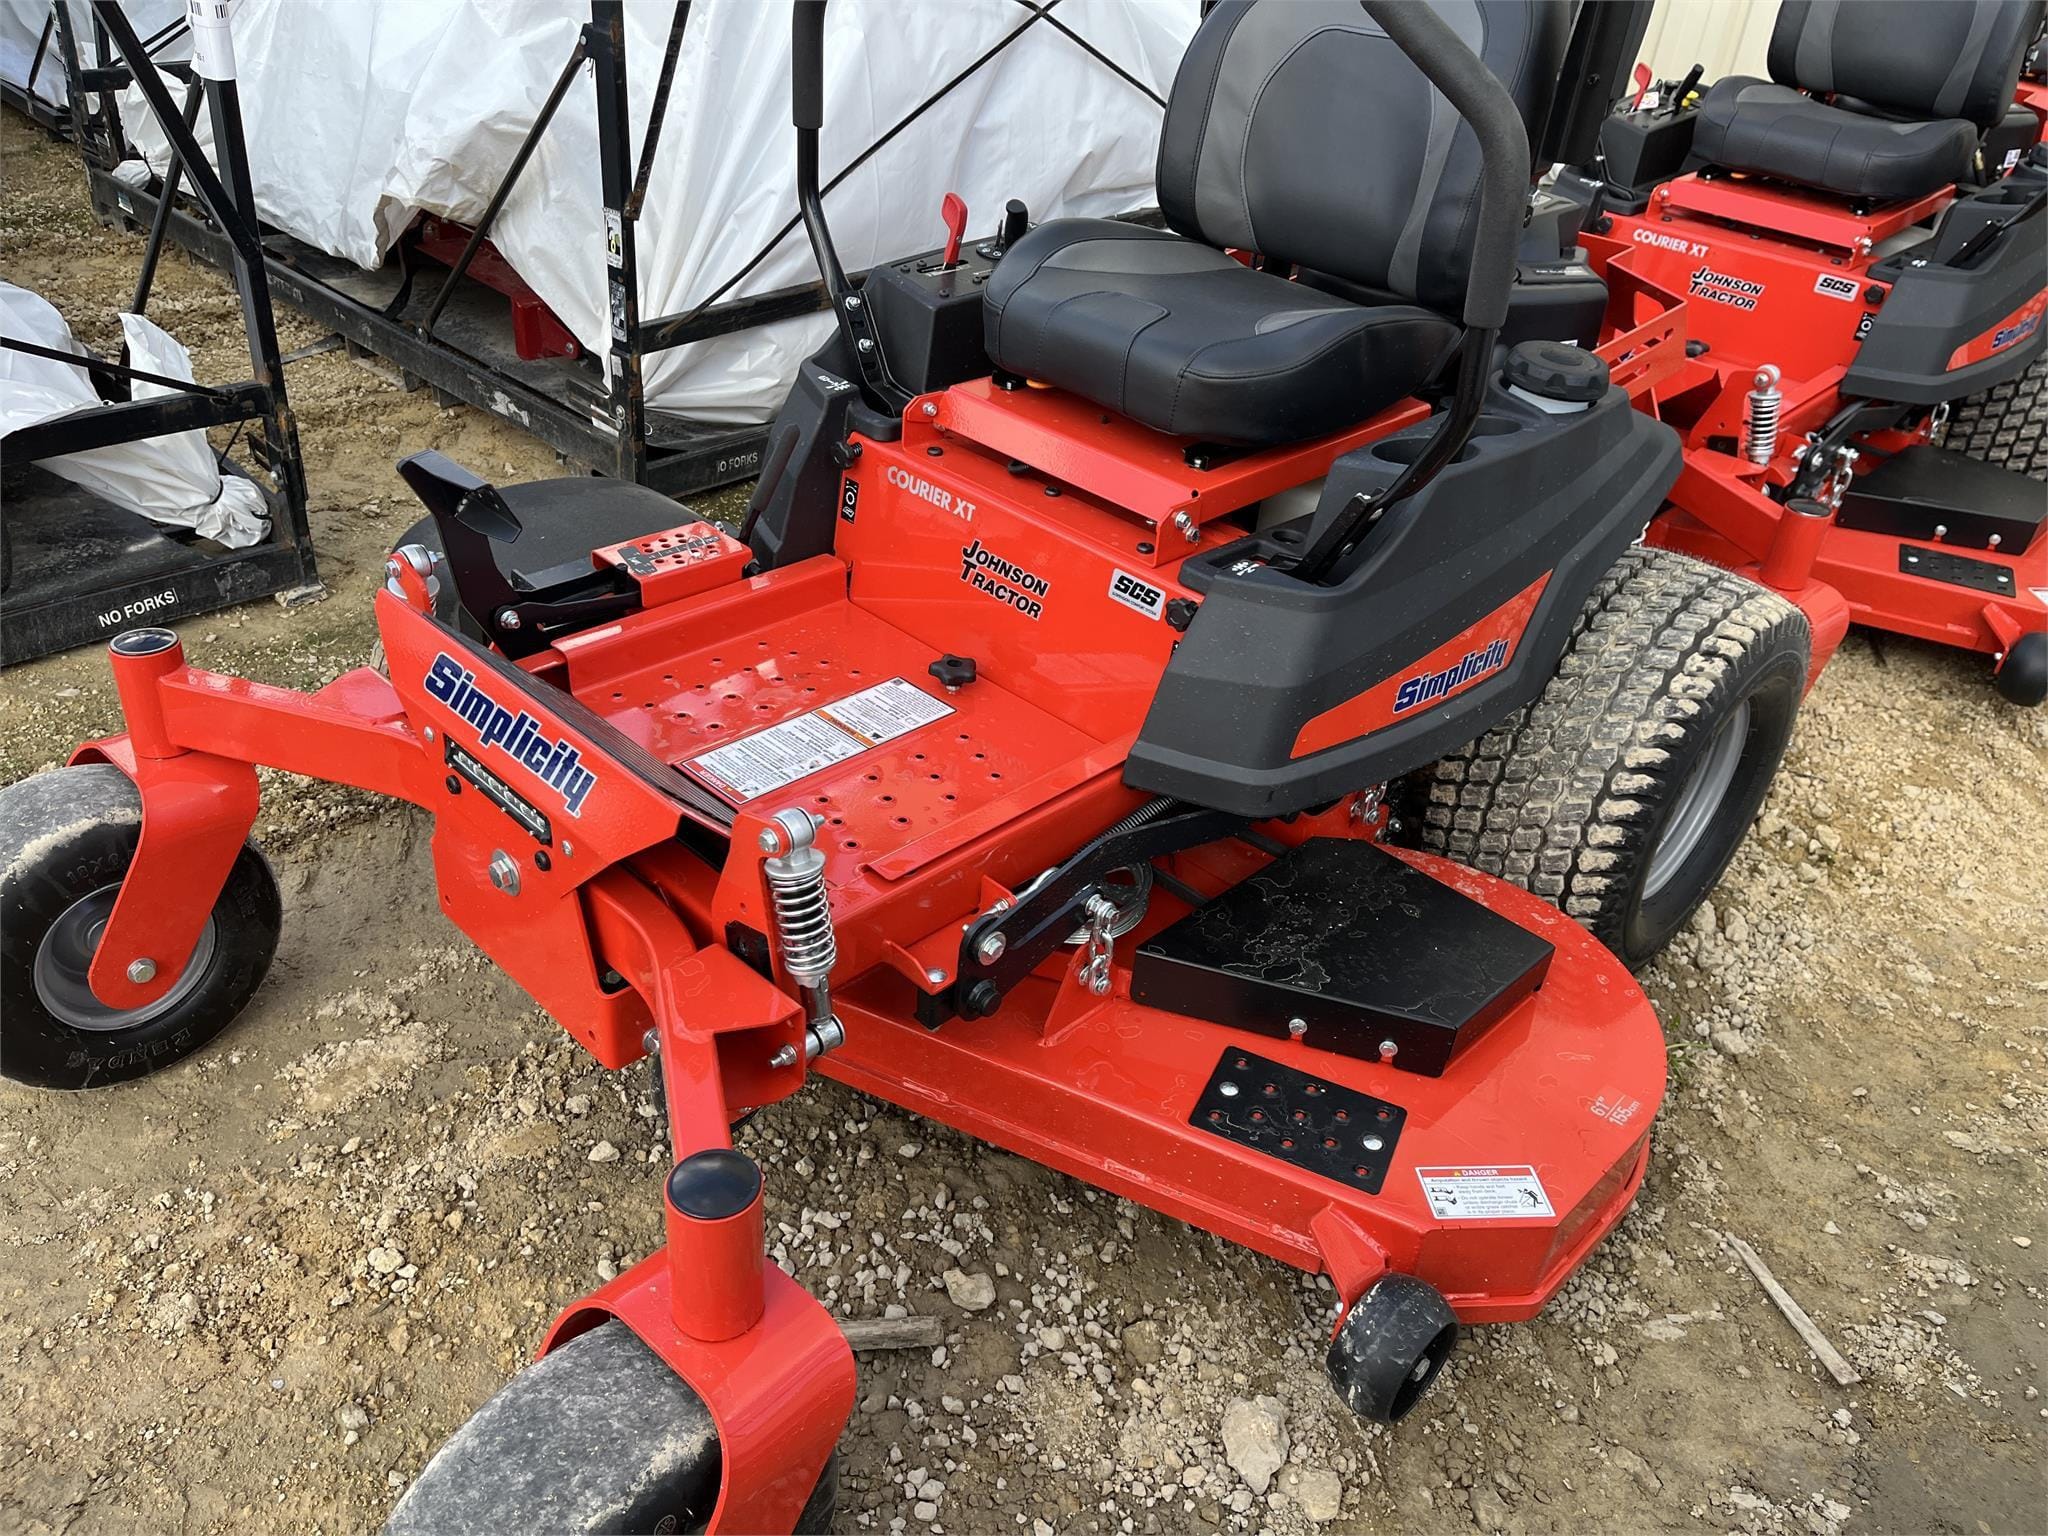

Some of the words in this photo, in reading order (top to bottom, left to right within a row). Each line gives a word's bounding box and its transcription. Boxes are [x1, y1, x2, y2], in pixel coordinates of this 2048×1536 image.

[1633, 228, 1688, 253] COURIER
[1689, 243, 1709, 258] XT
[1689, 280, 1758, 311] TRACTOR
[1692, 266, 1764, 296] JOHNSON
[1819, 277, 1856, 293] SCS
[887, 465, 952, 512] COURIER
[952, 499, 976, 522] XT
[962, 539, 1050, 597] JOHNSON
[960, 559, 1043, 619] TRACTOR
[1114, 575, 1161, 607] SCS
[98, 610, 122, 628] NO
[124, 590, 175, 618] FORKS
[1393, 640, 1510, 713] Simplicity
[424, 652, 597, 815] Simplicity
